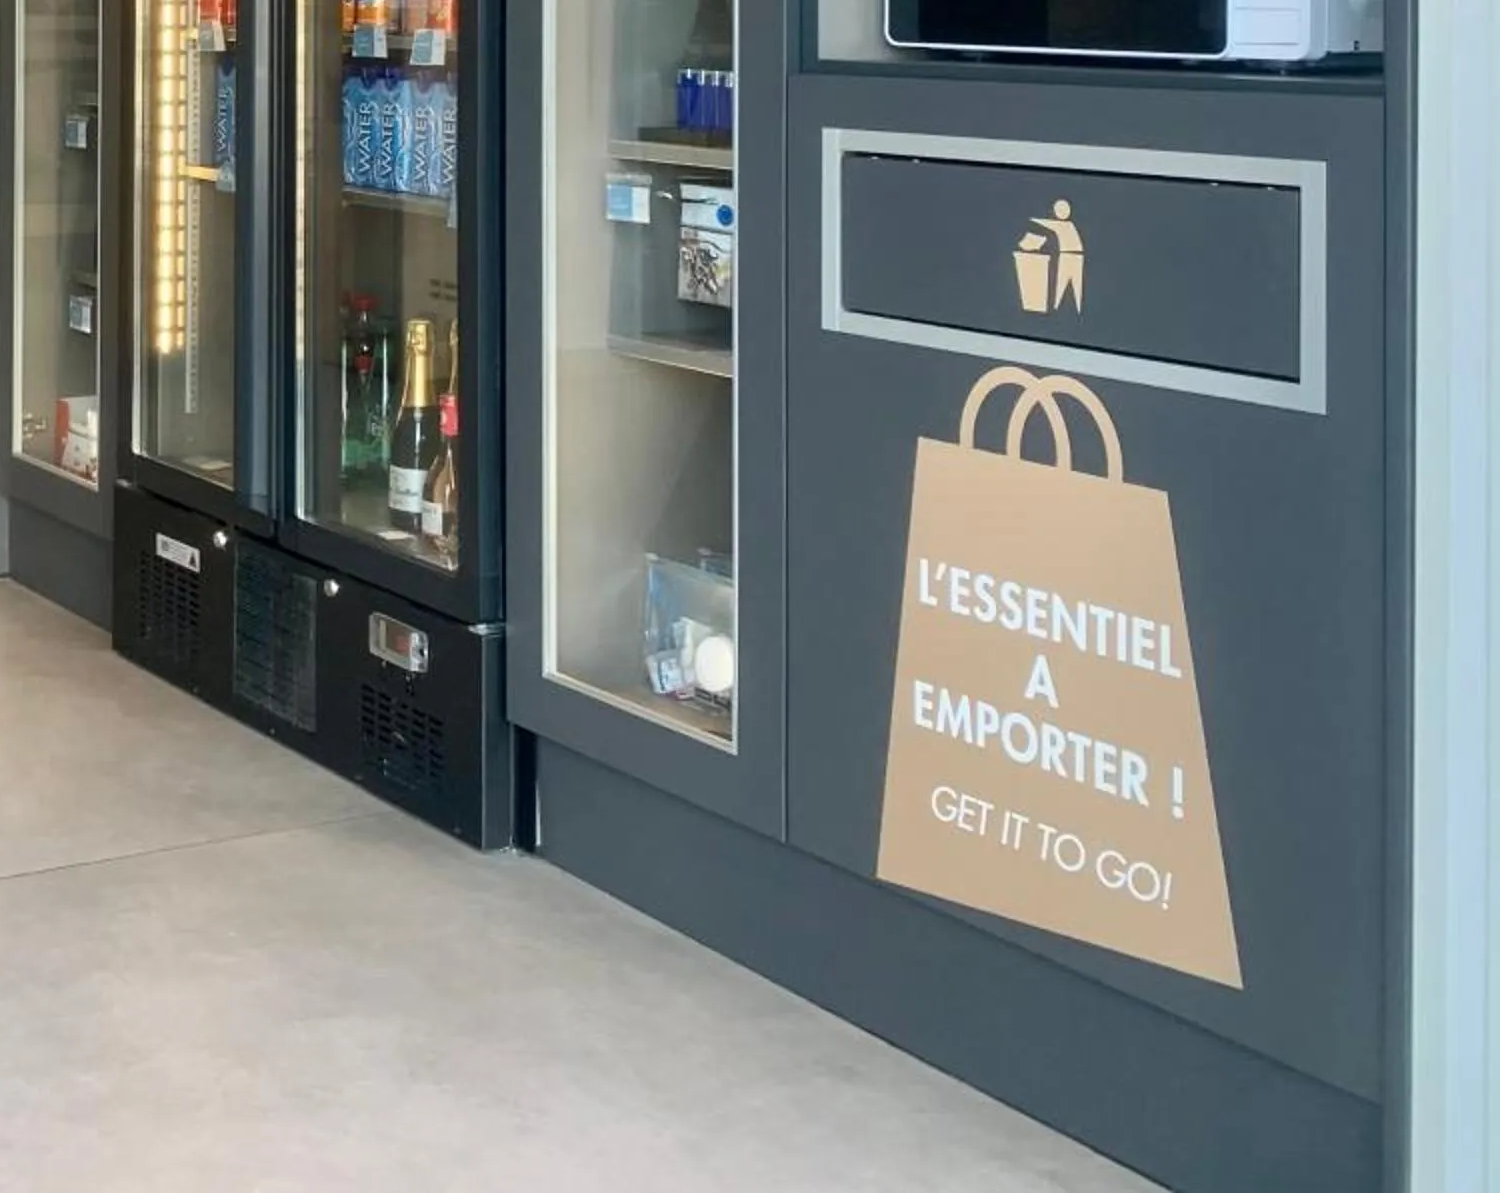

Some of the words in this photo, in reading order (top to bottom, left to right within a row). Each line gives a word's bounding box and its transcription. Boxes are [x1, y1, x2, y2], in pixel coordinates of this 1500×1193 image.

[358, 102, 371, 174] WATER
[380, 102, 394, 175] WATER
[414, 107, 427, 181] WATER
[443, 108, 457, 184] WATER
[918, 558, 1182, 679] L'ESSENTIEL
[1024, 654, 1059, 708] A
[914, 679, 1149, 807] EMPORTER
[1172, 766, 1184, 819] !
[931, 785, 994, 836] GET
[1000, 810, 1029, 850] IT
[1037, 823, 1086, 872] TO
[1096, 850, 1173, 910] GO!
